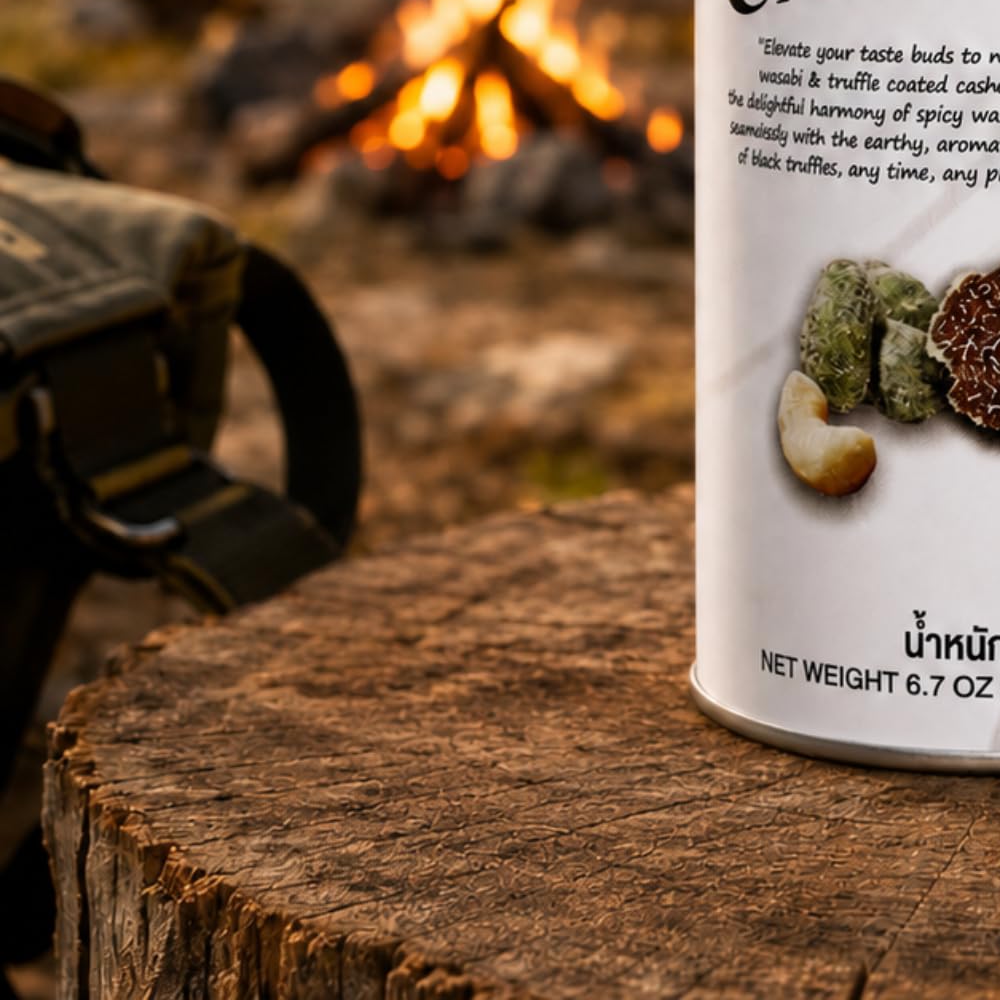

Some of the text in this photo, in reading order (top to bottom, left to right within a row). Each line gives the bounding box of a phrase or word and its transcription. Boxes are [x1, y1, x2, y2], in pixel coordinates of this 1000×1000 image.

[816, 48, 854, 65] your
[860, 45, 903, 63] taste
[911, 43, 954, 64] buds
[961, 48, 981, 64] to
[758, 68, 803, 87] wasabi
[808, 71, 821, 88] &
[828, 71, 880, 92] truffle
[886, 74, 948, 93] coated
[747, 92, 804, 118] delightful
[810, 99, 886, 127] harmony
[893, 102, 912, 122] of
[916, 104, 963, 128] spicy
[793, 128, 825, 147] with
[831, 130, 858, 149] the
[864, 133, 929, 157] earthy,
[751, 149, 782, 171] black
[786, 155, 843, 178] truffles,
[848, 163, 880, 184] any
[887, 161, 935, 183] time,
[942, 166, 978, 187] any
[761, 649, 798, 678] NET
[802, 659, 899, 693] WEIGHT
[905, 674, 945, 696] 6.7
[953, 676, 994, 698] OZ
